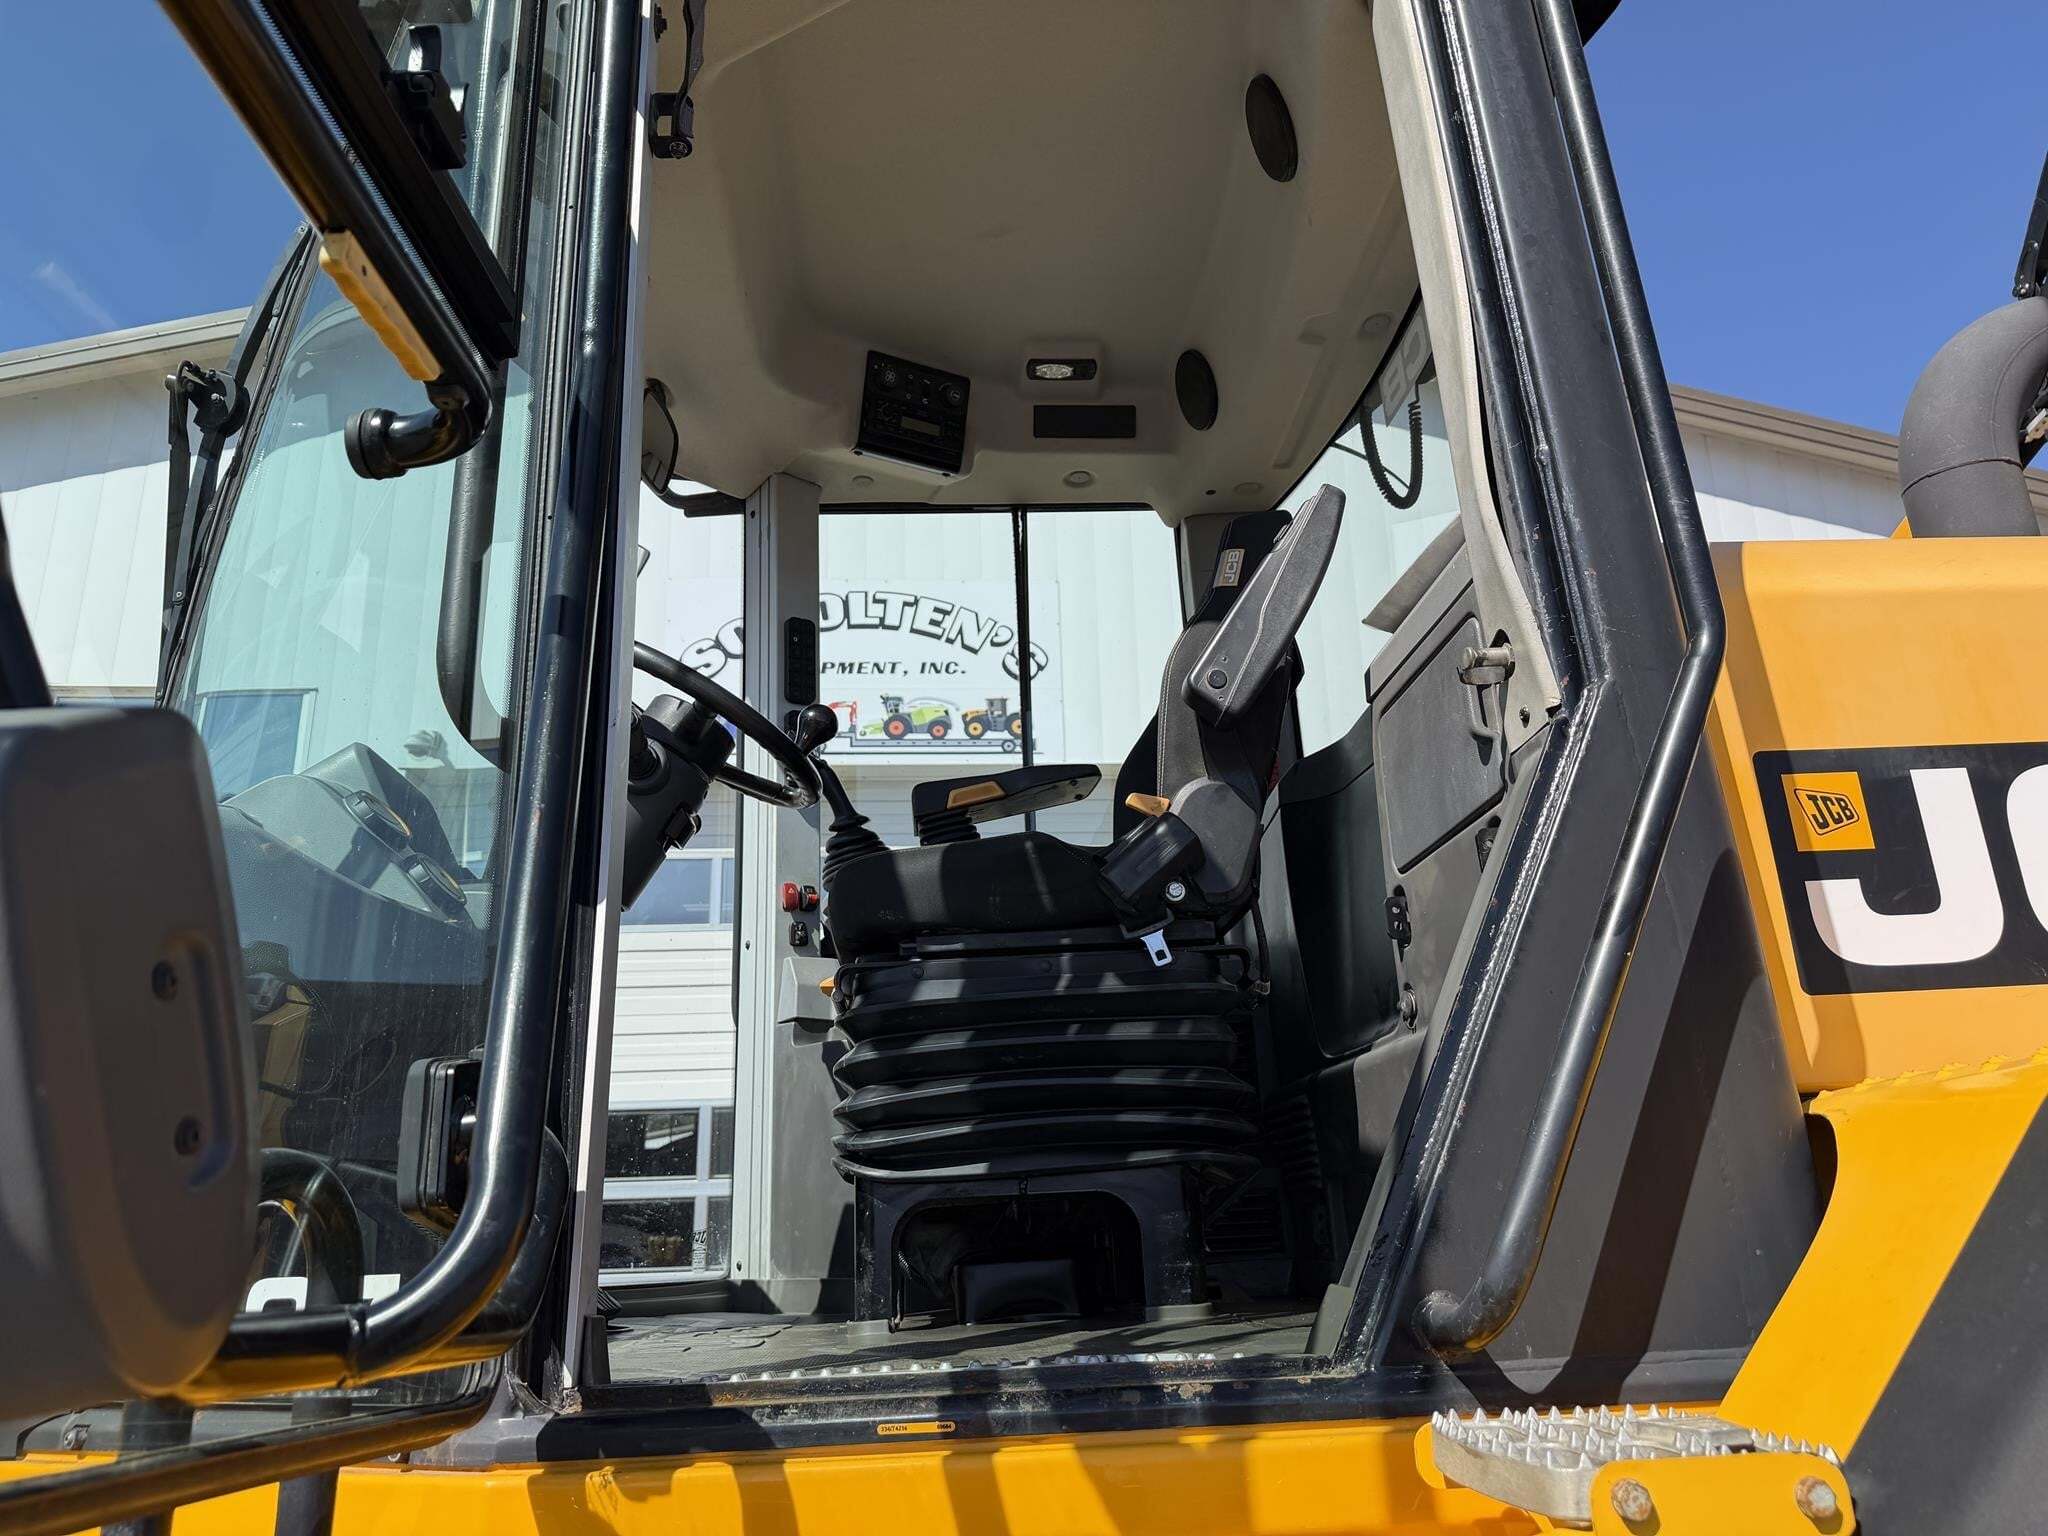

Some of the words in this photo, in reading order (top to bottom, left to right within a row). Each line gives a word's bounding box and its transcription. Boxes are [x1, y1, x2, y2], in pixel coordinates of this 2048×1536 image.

[1224, 551, 1240, 583] JCB
[919, 661, 967, 675] INC.
[1807, 794, 1855, 830] JCB
[1804, 764, 2048, 966] J
